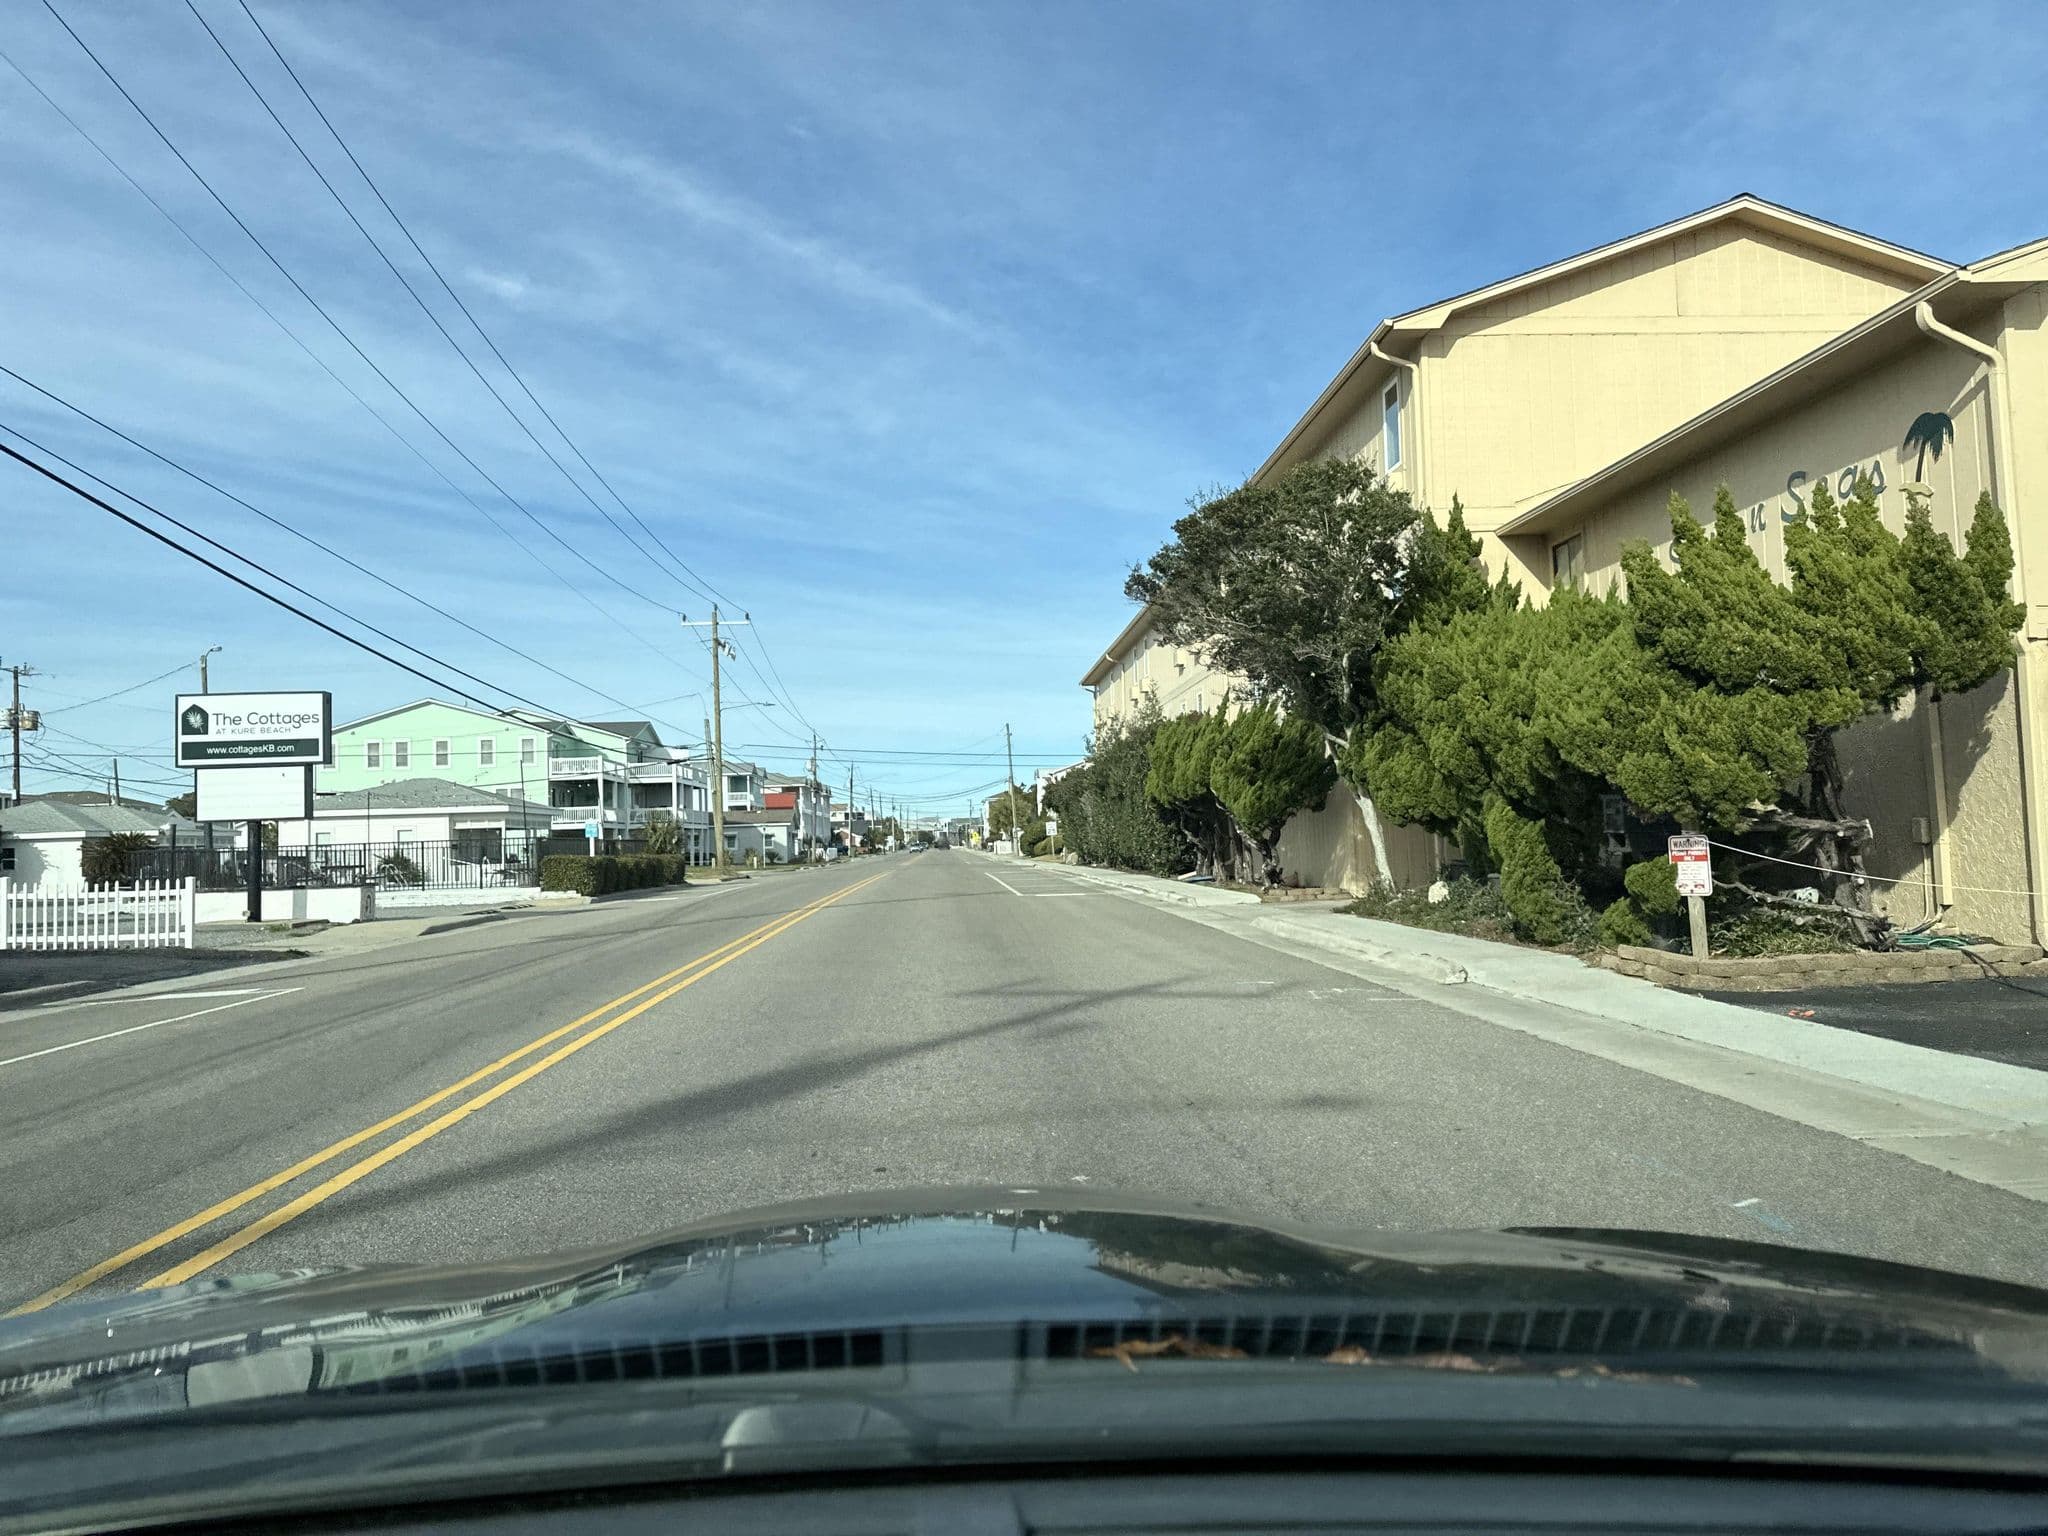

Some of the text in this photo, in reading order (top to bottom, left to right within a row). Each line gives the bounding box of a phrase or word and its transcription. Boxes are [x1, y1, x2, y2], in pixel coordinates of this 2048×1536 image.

[212, 711, 320, 729] The Cottages
[231, 727, 256, 735] KURE
[260, 726, 291, 734] BEACH
[206, 744, 295, 755] www.cottagesKB.com
[1672, 840, 1705, 848] WARNING
